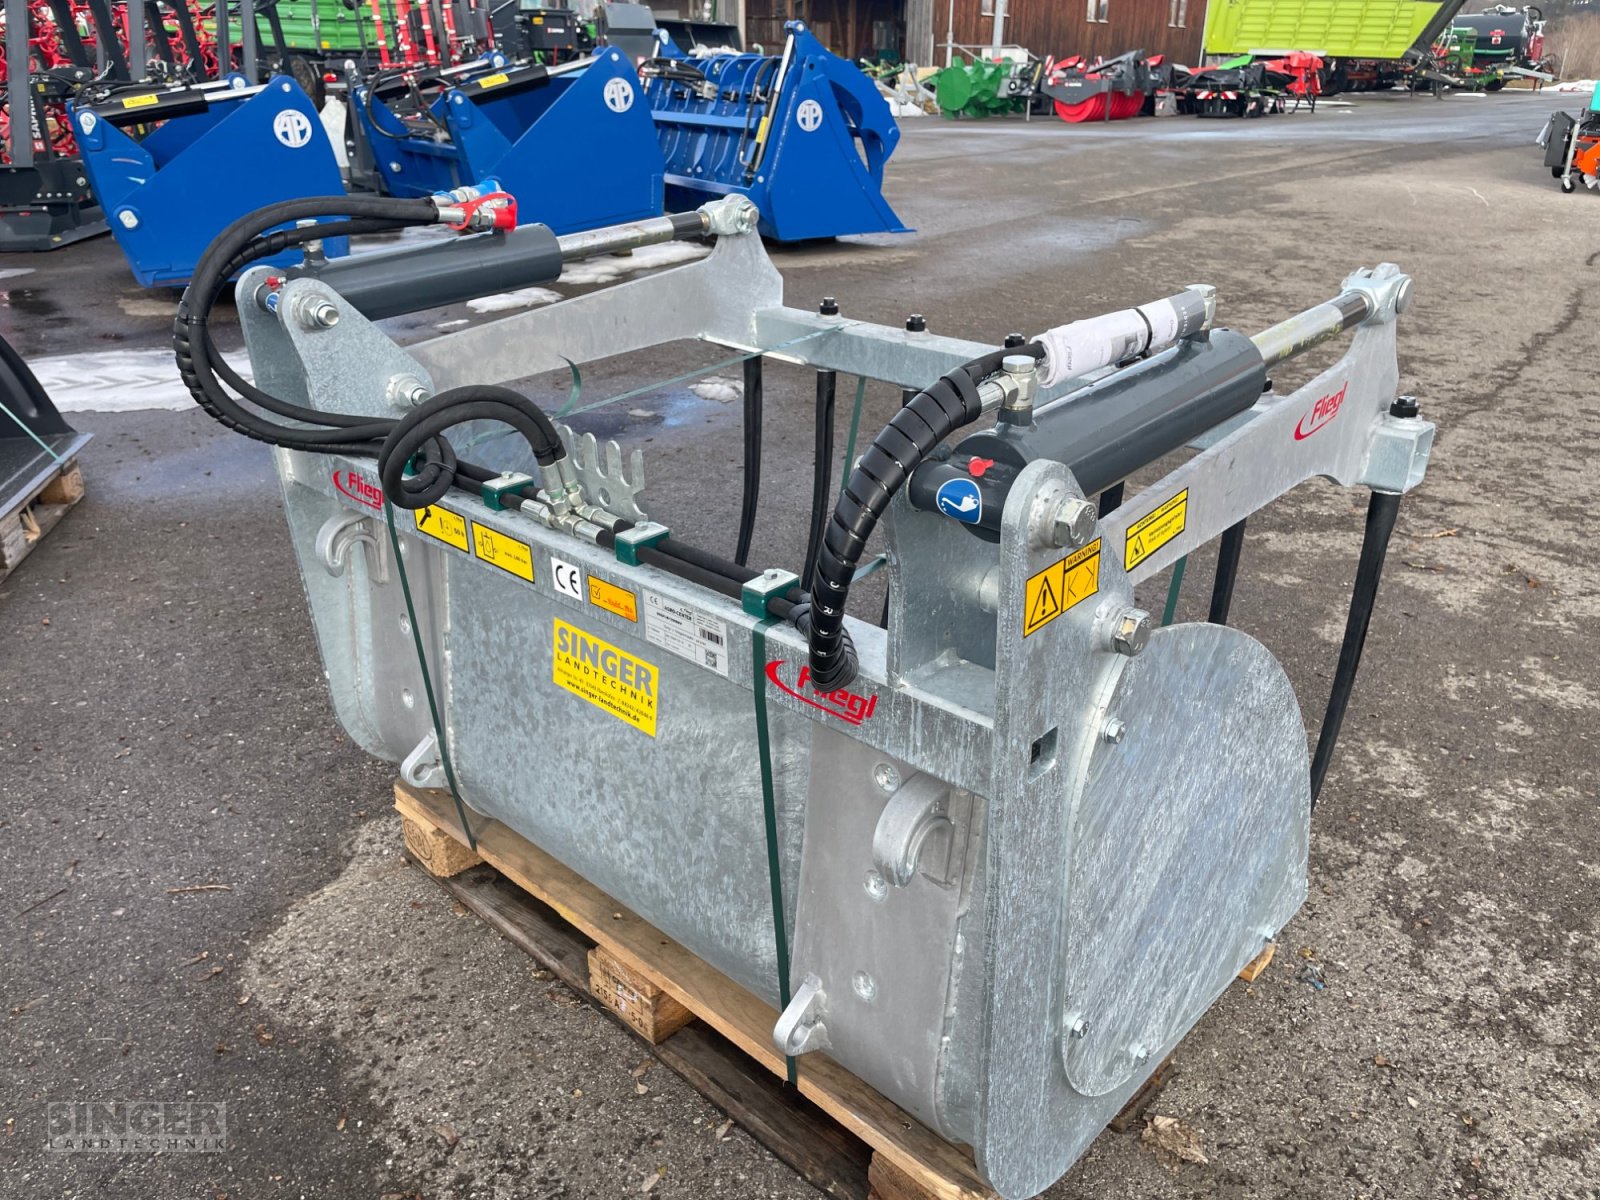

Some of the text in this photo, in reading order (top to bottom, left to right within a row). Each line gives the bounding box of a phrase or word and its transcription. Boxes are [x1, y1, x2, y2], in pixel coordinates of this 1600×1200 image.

[1310, 380, 1349, 426] Fliegl
[1067, 542, 1099, 567] WARNING!
[557, 652, 653, 709] LANDTECHNIK
[558, 626, 653, 697] SINGER
[797, 665, 879, 720] Fegl
